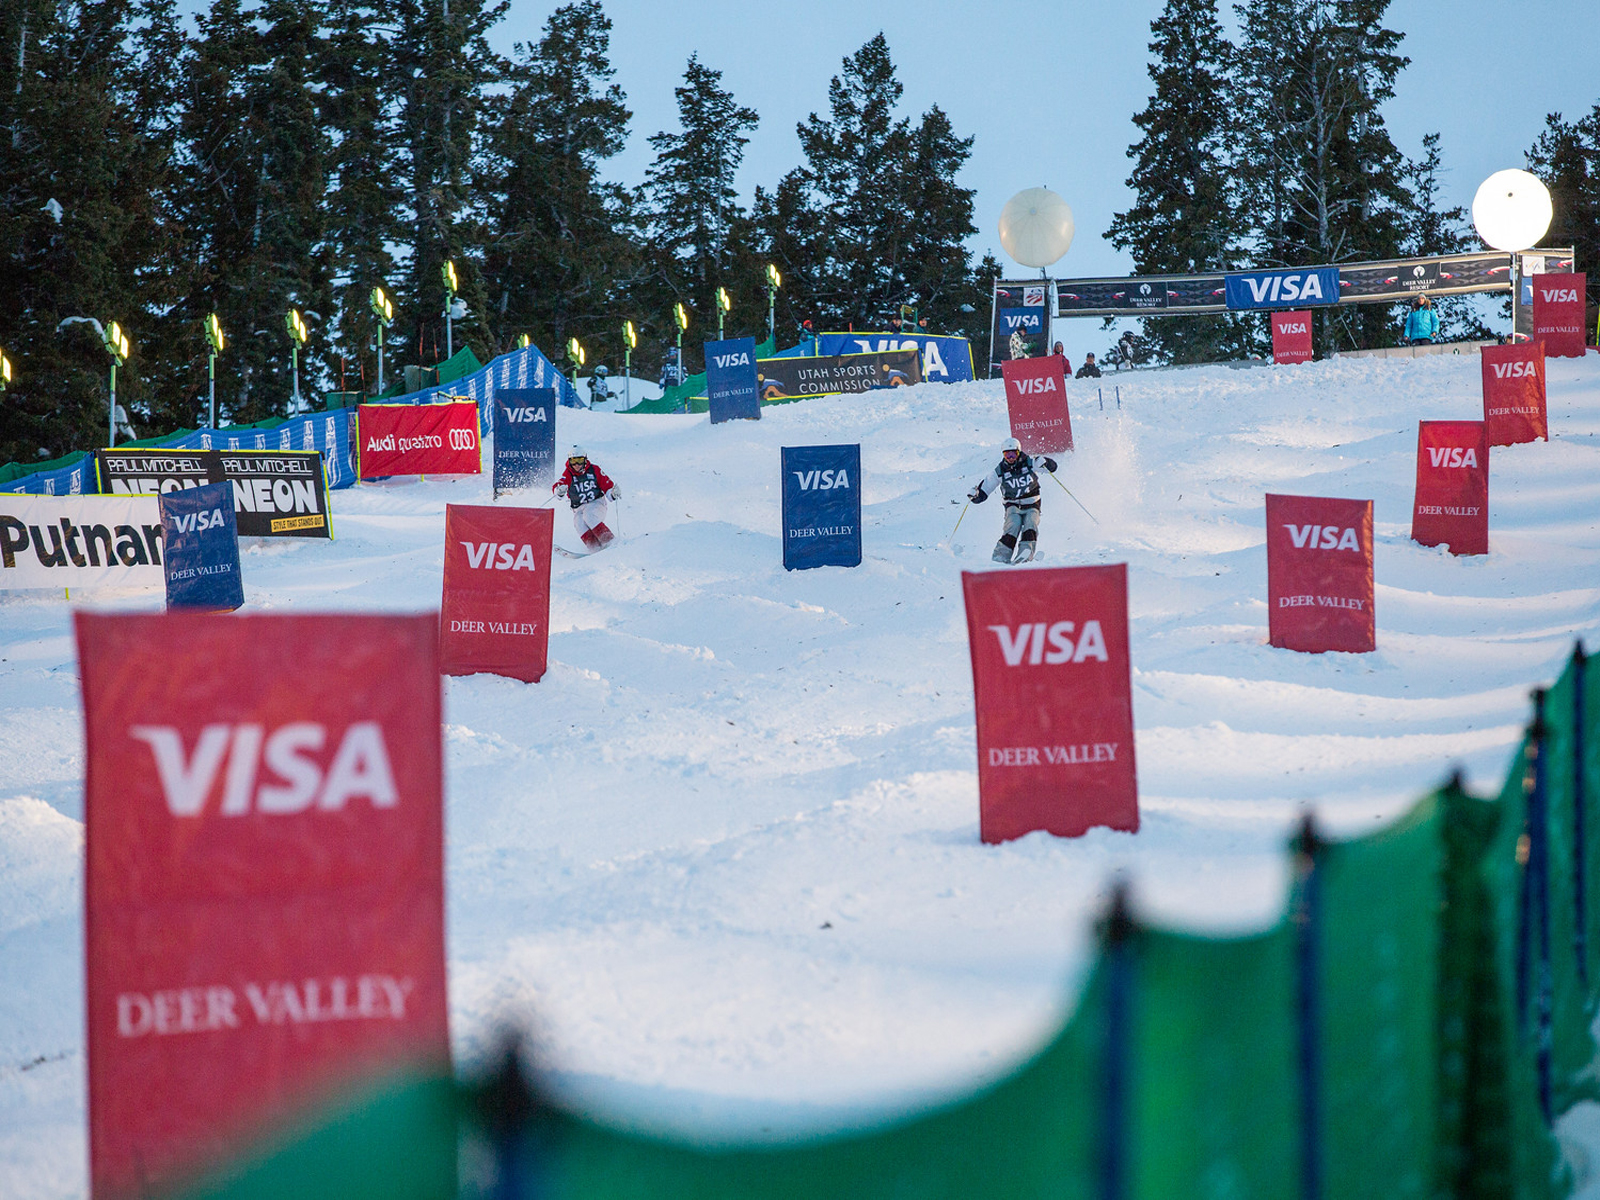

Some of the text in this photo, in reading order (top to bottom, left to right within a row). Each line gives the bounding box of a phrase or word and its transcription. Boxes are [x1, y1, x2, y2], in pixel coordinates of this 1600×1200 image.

[1241, 274, 1323, 302] VISA
[1540, 289, 1578, 303] VISA
[1004, 315, 1039, 328] VISA
[1277, 323, 1307, 335] VISA
[1537, 326, 1555, 334] DEER
[713, 352, 750, 368] VISA
[798, 364, 876, 380] UTAH SPORTS
[1490, 361, 1536, 379] VISA
[713, 387, 754, 399] DEER VALLEY
[799, 378, 880, 394] COMMISSION
[1012, 377, 1056, 395] VISA
[503, 406, 547, 423] VISA
[1488, 406, 1540, 416] DEER VALLEY
[1014, 418, 1064, 431] DEER VALLEY
[367, 434, 442, 454] Audi quattro
[498, 450, 549, 459] DEER VALLEY
[1426, 447, 1478, 469] VISA
[108, 459, 207, 472] PAUL MITCHELL
[222, 459, 314, 473] PAUL MITCHELL
[574, 480, 597, 493] VISA
[793, 468, 850, 491] VISA
[1005, 474, 1034, 489] VISA
[229, 478, 318, 513] NEON
[578, 491, 596, 504] 23
[1418, 505, 1480, 516] DEER VALLEY
[171, 508, 225, 534] VISA
[273, 520, 287, 531] STYLE
[789, 525, 853, 539] DEER VALLEY
[1283, 524, 1361, 552] VISA
[0, 514, 162, 569] Putna
[460, 541, 536, 572] VISA
[171, 563, 233, 581] DEER VALLEY
[1279, 595, 1365, 611] DEER VALLEY
[450, 620, 537, 636] DEER VALLEY
[987, 620, 1109, 667] VISA
[988, 743, 1119, 767] DEER VALLEY
[131, 721, 400, 818] VISA
[117, 974, 413, 1037] DEER VALLEY
